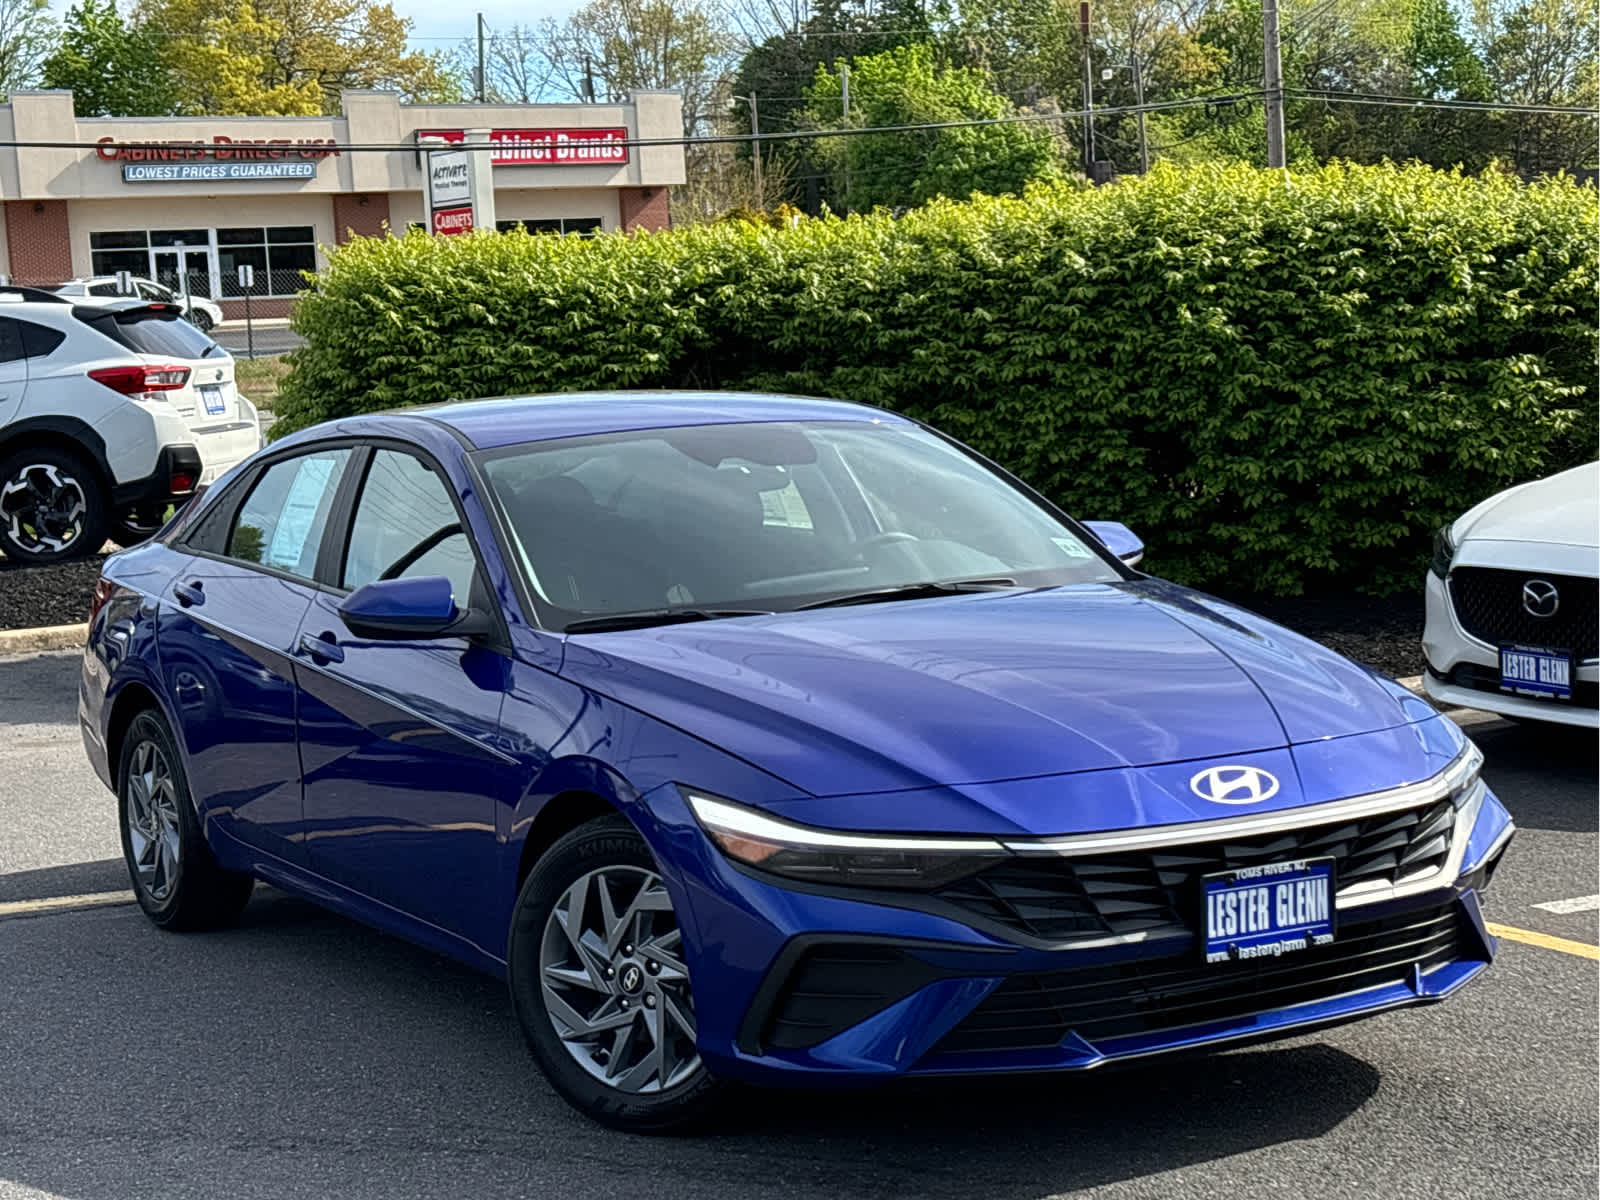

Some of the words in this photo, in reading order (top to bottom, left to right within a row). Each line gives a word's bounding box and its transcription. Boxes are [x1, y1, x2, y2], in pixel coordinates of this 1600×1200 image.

[213, 136, 292, 160] DIRECT
[297, 139, 341, 158] USA
[490, 135, 552, 159] abinet
[556, 133, 624, 159] Brands
[129, 167, 180, 178] LOWEST
[182, 166, 226, 178] PRICES
[230, 164, 313, 177] GUARANTEED
[433, 164, 467, 179] ACTIVATE
[435, 212, 472, 229] CABINETS
[1502, 653, 1537, 681] LESTER
[1539, 658, 1570, 686] GLENN
[1235, 867, 1263, 881] TOMS
[1208, 887, 1270, 939] LESTER
[1276, 878, 1329, 928] GLENN
